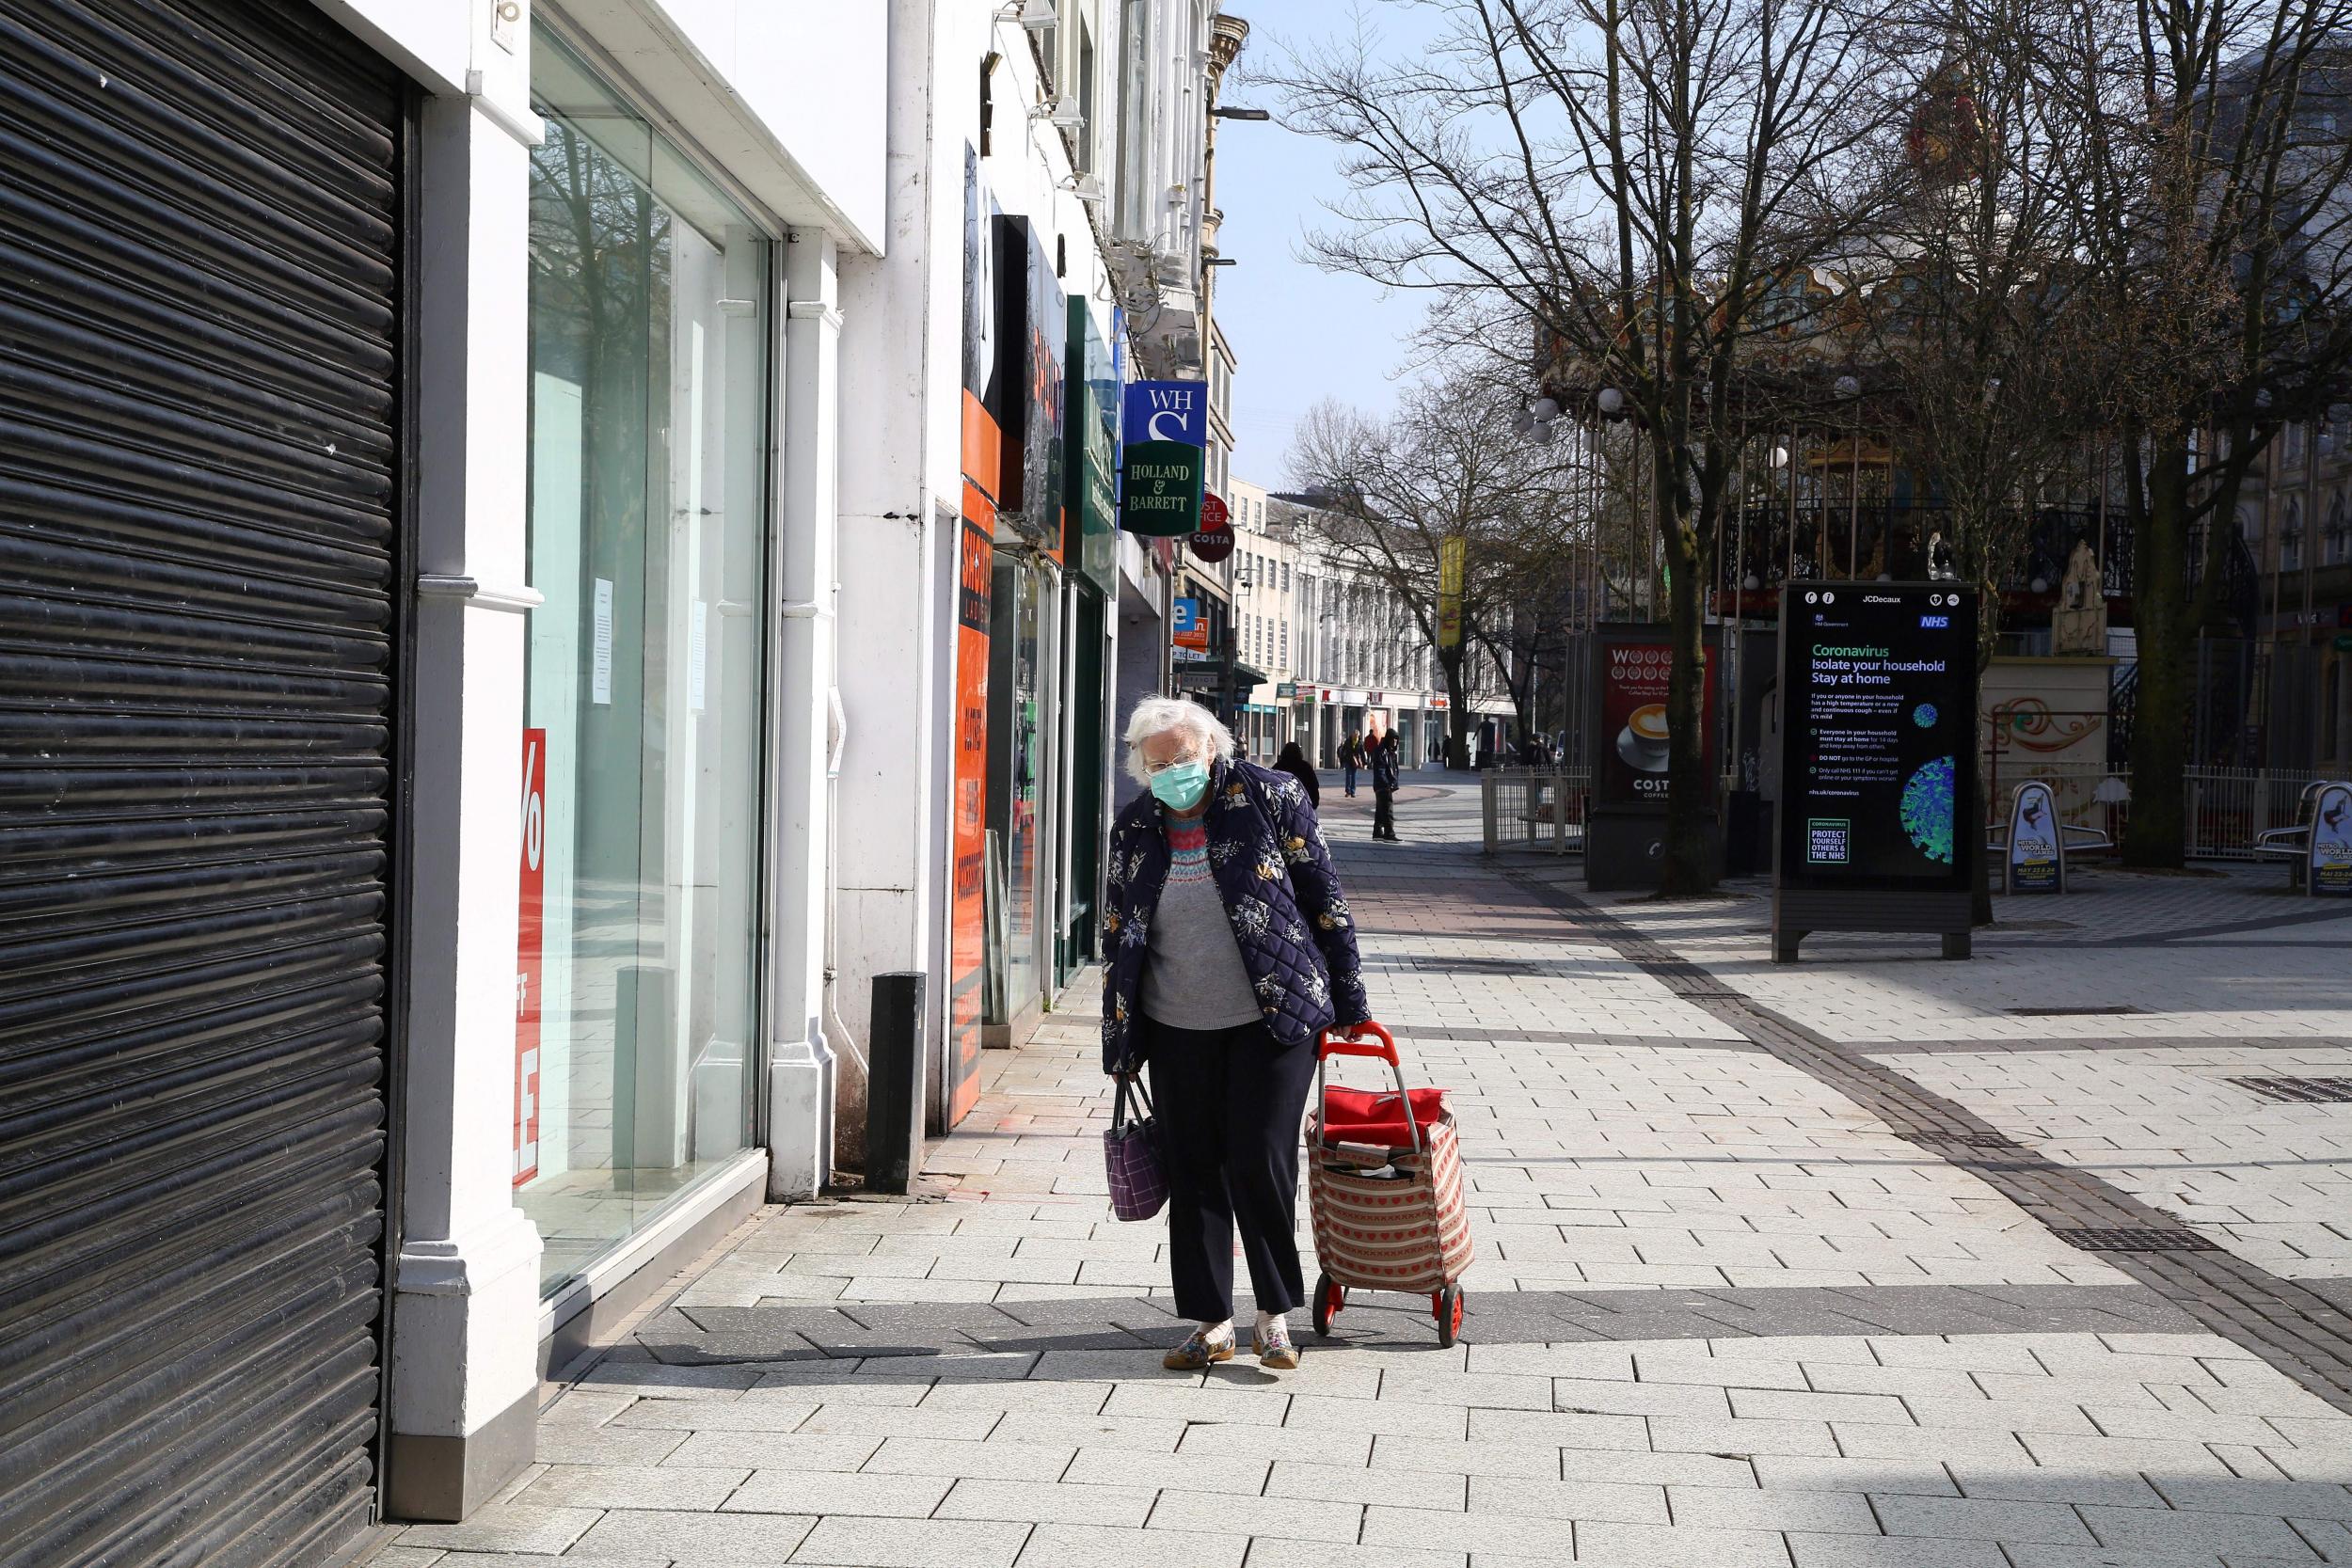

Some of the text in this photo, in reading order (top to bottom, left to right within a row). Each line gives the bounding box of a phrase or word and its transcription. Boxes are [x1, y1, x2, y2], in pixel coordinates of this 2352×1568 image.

[1149, 389, 1193, 410] WH
[1131, 465, 1189, 481] HOLLAND
[1153, 480, 1166, 495] &
[1129, 497, 1186, 513] BARRETT
[1194, 534, 1230, 545] COSTA
[1920, 617, 1948, 627] NHS
[1812, 644, 1889, 657] Coronavirus
[1812, 658, 1946, 673] Isolate your household
[1812, 672, 1891, 686] Stay at home
[1633, 779, 1669, 791] COST
